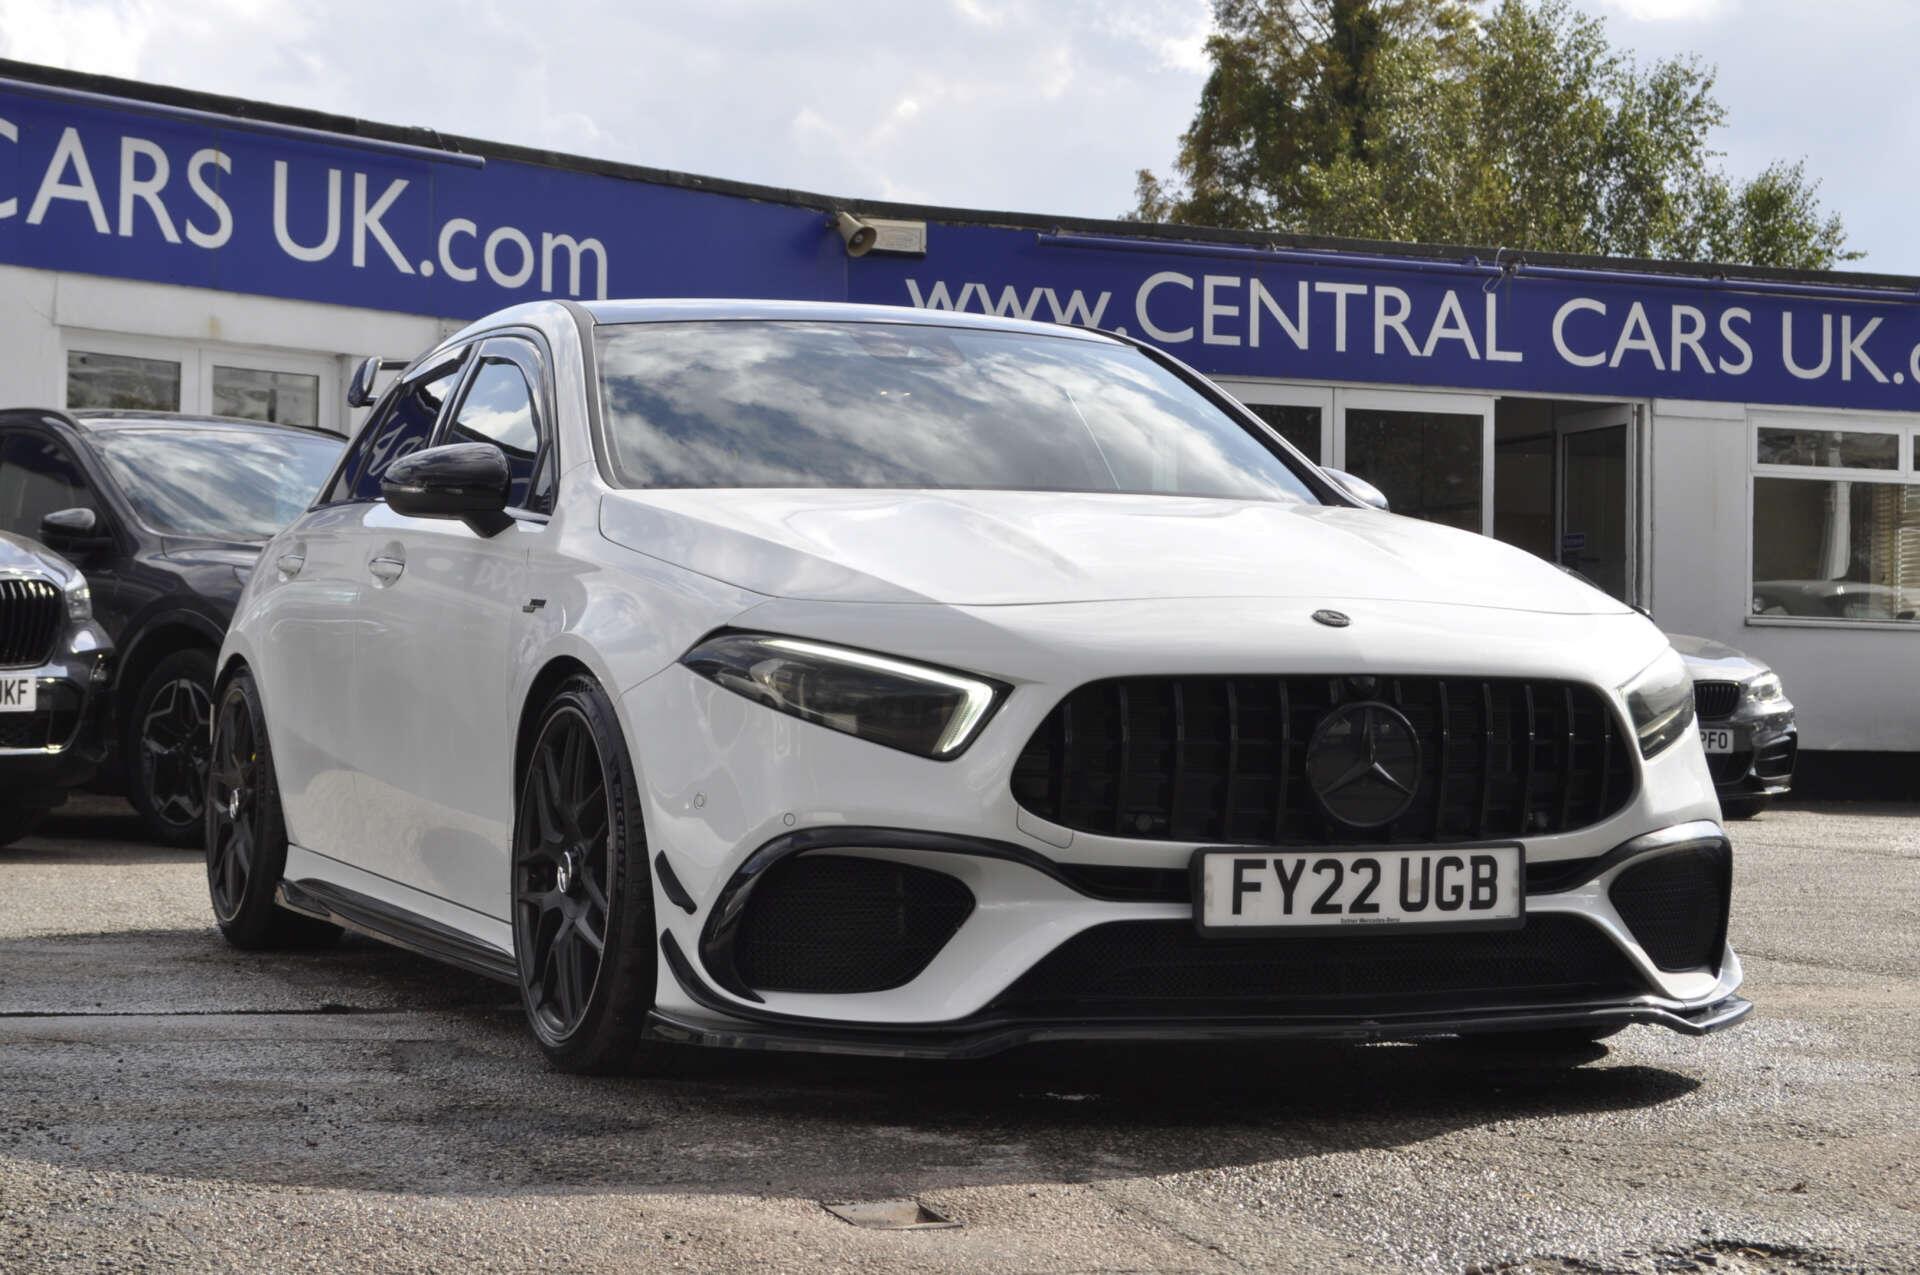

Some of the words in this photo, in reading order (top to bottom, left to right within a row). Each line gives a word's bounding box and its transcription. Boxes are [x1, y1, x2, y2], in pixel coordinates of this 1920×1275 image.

[0, 117, 233, 249] ARS
[273, 160, 608, 300] UK.com
[1552, 298, 1753, 375] CARS
[0, 679, 29, 706] KF
[1232, 858, 1382, 916] FY22
[1399, 855, 1499, 912] UGB
